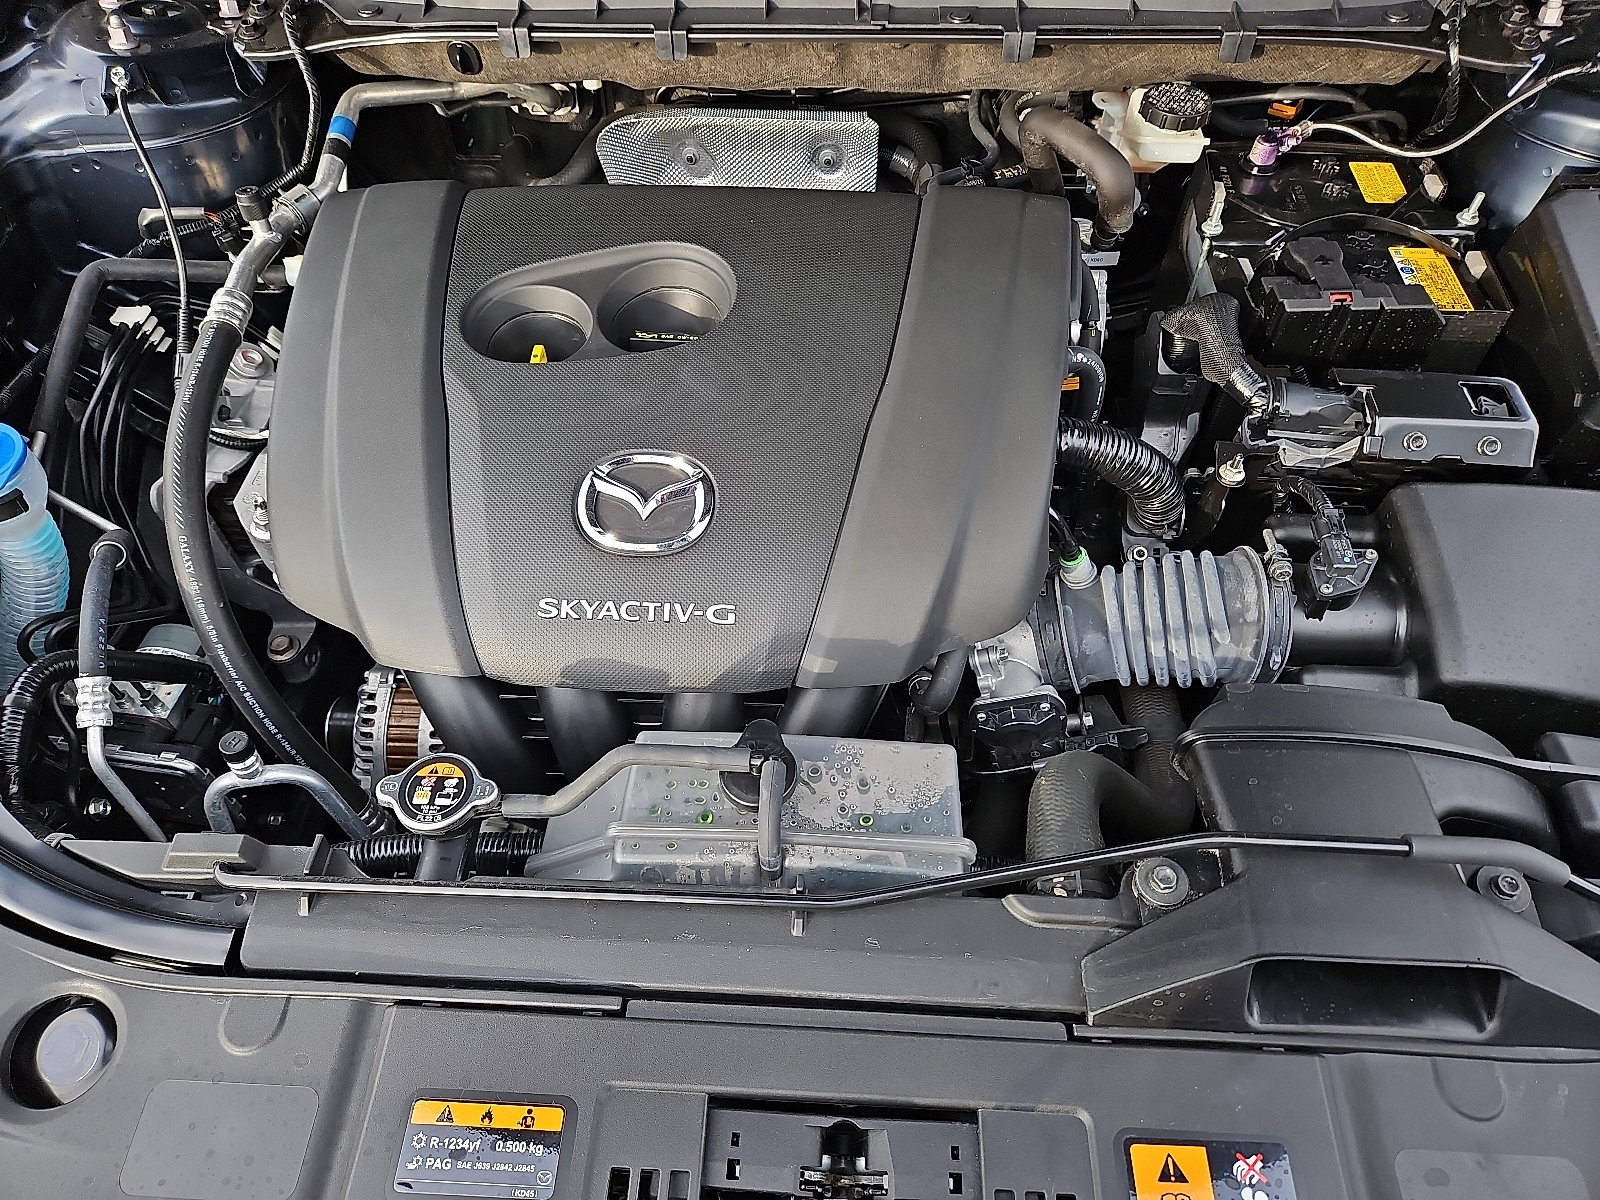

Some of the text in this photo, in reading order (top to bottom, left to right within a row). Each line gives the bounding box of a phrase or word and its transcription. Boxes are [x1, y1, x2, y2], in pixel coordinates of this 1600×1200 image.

[536, 597, 738, 626] SKYACTIV-G
[178, 535, 196, 575] GALAXY
[243, 691, 266, 719] SUCTION
[225, 735, 242, 750] H
[429, 1136, 544, 1157] R-1234yf 0.500 kg
[425, 1157, 452, 1171] PAG
[456, 1160, 472, 1170] SAE
[491, 1163, 513, 1173] J2842
[513, 1164, 536, 1174] J2845
[511, 1188, 539, 1198] (KD45)
